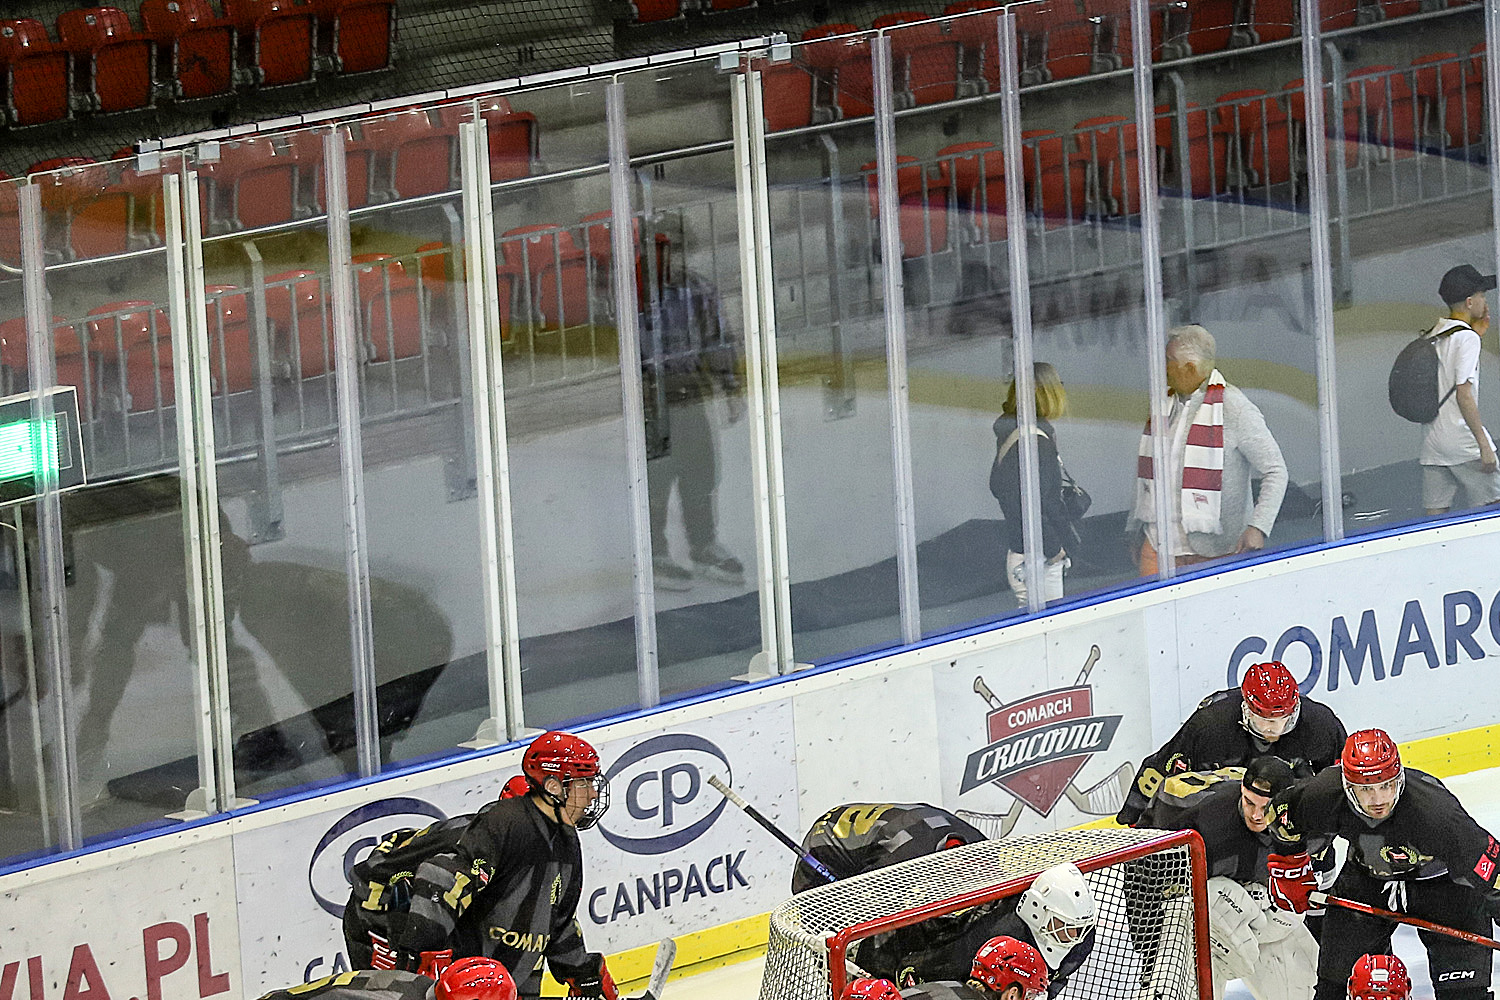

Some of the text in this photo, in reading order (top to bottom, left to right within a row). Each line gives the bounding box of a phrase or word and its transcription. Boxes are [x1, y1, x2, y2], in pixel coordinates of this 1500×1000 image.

[1007, 696, 1073, 729] COMARCH
[1271, 861, 1313, 879] CCM
[588, 850, 749, 925] CANPACK
[1439, 970, 1476, 983] CCM
